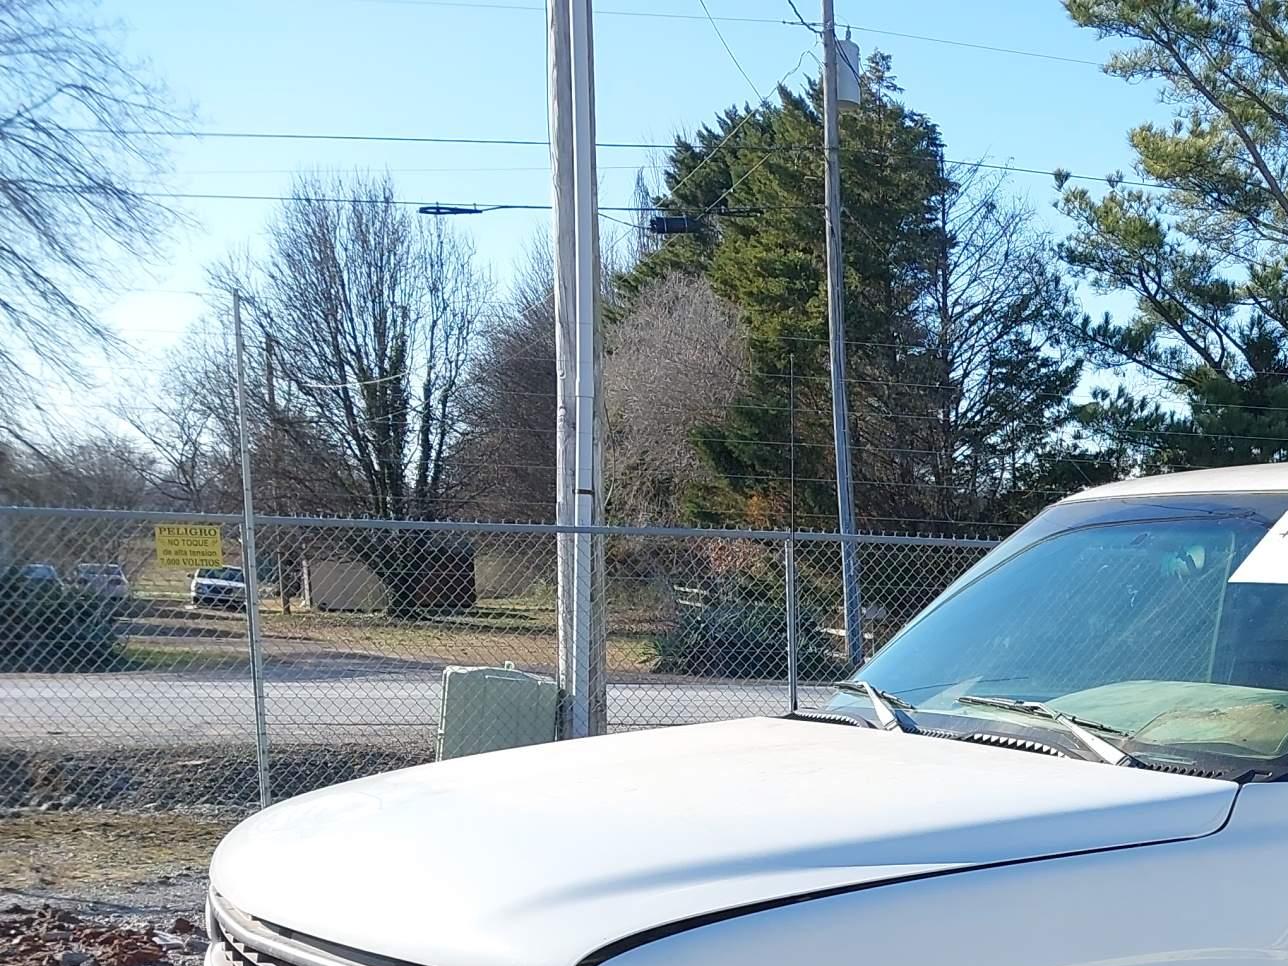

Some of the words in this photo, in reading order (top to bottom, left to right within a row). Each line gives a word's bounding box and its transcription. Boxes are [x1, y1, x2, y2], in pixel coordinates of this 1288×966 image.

[159, 527, 217, 536] PELIGRO
[168, 539, 179, 547] NO
[182, 539, 208, 547] TOQUE
[182, 558, 220, 567] VOLTIOS
